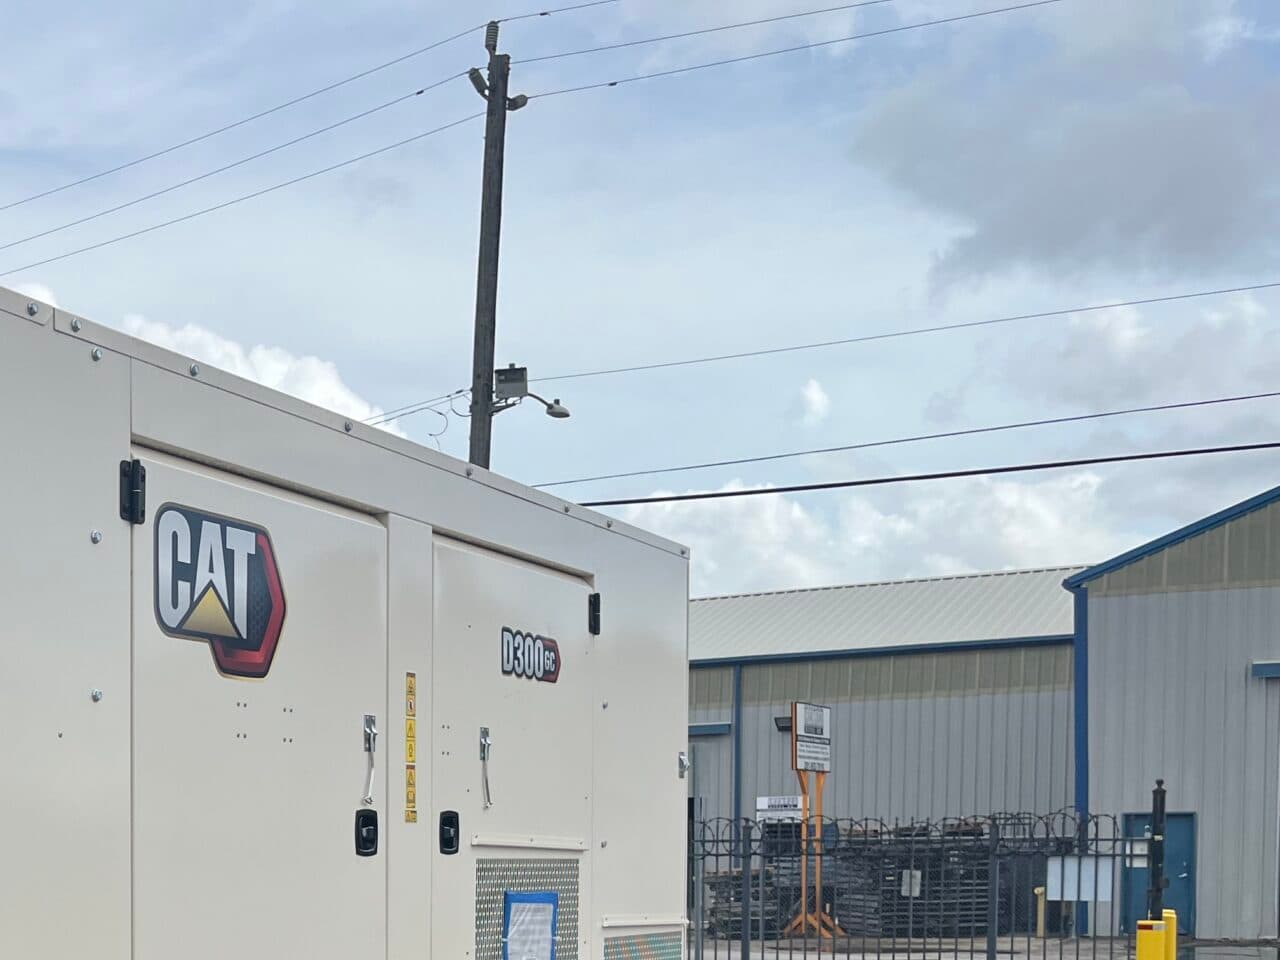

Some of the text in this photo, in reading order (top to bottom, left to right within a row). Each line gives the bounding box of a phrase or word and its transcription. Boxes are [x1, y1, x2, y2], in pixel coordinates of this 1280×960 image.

[157, 509, 256, 640] CAT
[502, 629, 556, 679] D300 GC
